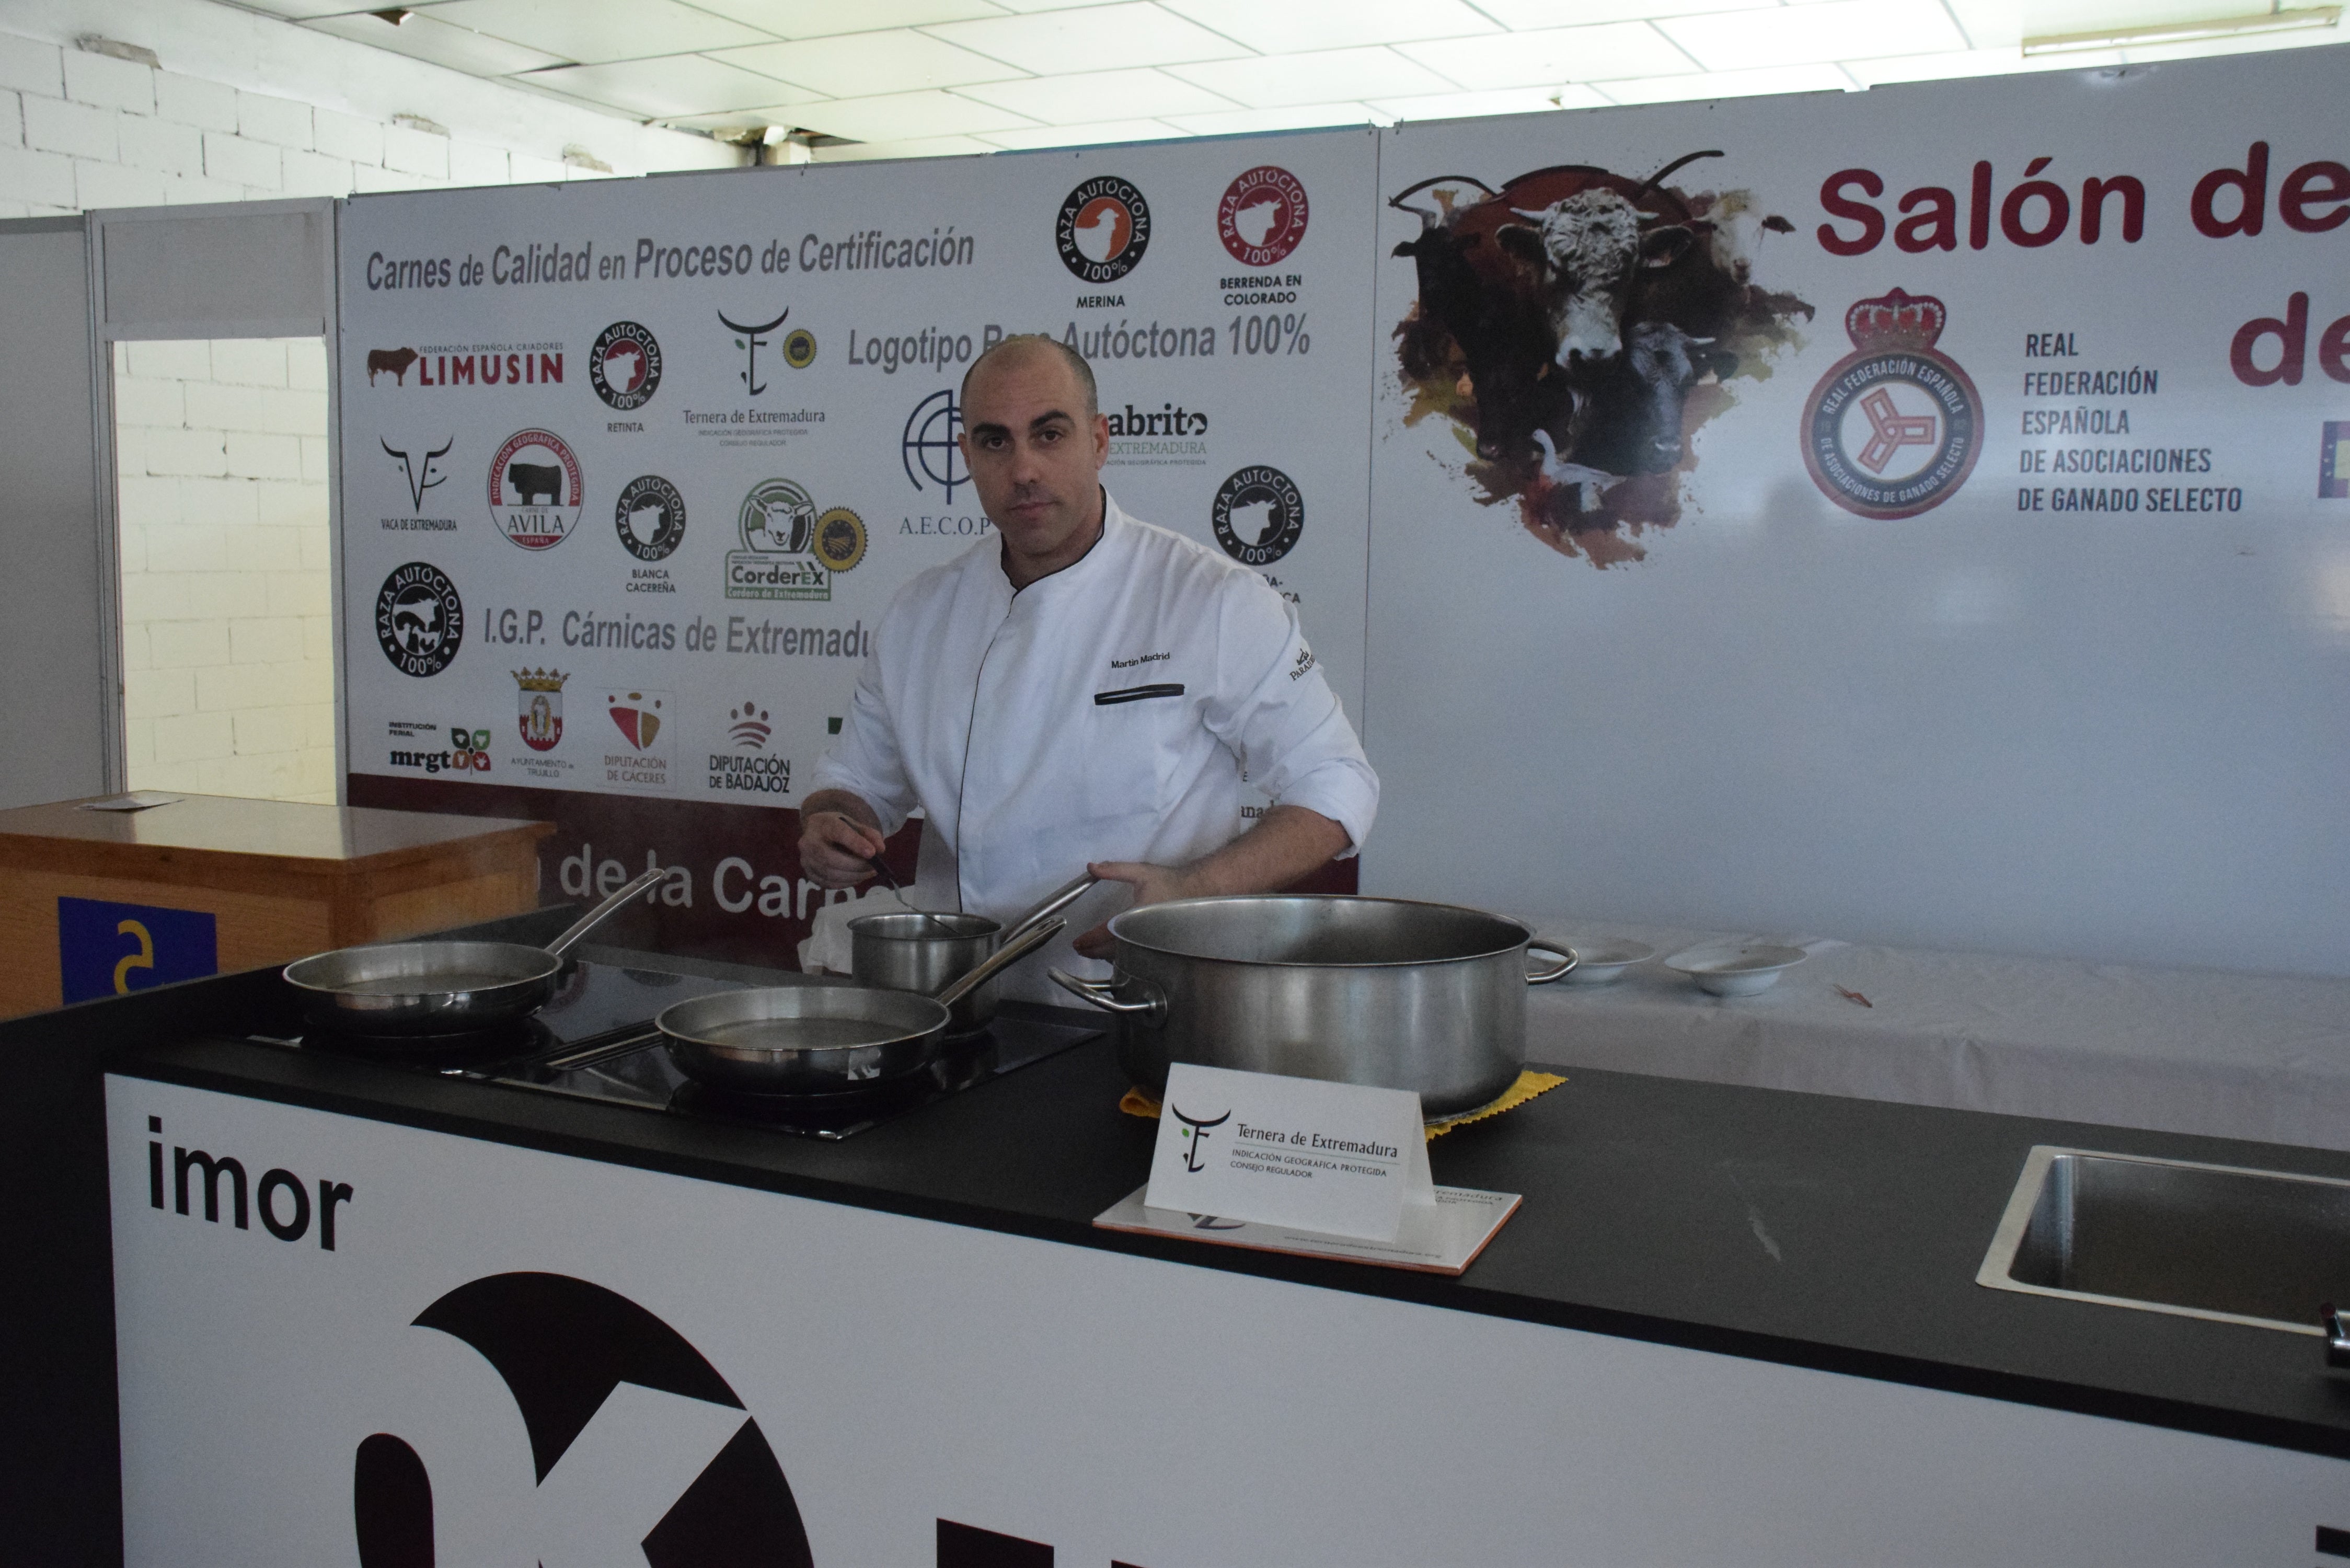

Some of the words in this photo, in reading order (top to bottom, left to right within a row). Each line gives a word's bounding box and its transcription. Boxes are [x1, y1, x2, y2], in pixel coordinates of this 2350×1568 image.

[1222, 194, 1238, 238] RAZA
[1238, 169, 1306, 229] AUTÓCTONA
[1816, 156, 2146, 257] Salón
[2190, 141, 2350, 238] de
[1062, 206, 1077, 252] RAZA
[1076, 179, 1147, 244] AUTÓCTONA
[367, 251, 451, 291] Carnes
[459, 255, 484, 286] de
[492, 241, 592, 285] Calidad
[599, 253, 626, 280] en
[634, 237, 753, 279] Proceso
[762, 239, 790, 274] de
[799, 226, 974, 272] Certificación
[1242, 245, 1287, 263] 100%
[1082, 261, 1128, 281] 100%
[1220, 275, 1282, 290] BERRENDA
[1286, 274, 1302, 287] EN
[1076, 295, 1125, 309] MERINA
[1224, 291, 1297, 306] COLORADO
[420, 345, 468, 353] FEDERACIÓN
[472, 342, 513, 352] ESPAÑOLA
[516, 342, 563, 351] CRIADORES
[593, 345, 606, 385] RAZA
[605, 324, 659, 379] AUTÓCTONA
[848, 326, 972, 374] Logotipo
[1063, 318, 1215, 360] Autóctona
[1228, 313, 1310, 356] 100%
[2025, 332, 2079, 358] REAL
[420, 353, 563, 386] LIMUSIN
[2023, 366, 2158, 396] FEDERACIÓN
[1823, 385, 1848, 415] REAL
[1845, 358, 1916, 391] FEDERACIÓN
[1917, 365, 1965, 414] ESPAÑOLA
[610, 393, 646, 408] 100%
[607, 422, 644, 433] RETINTA
[683, 410, 727, 423] Ternera
[731, 410, 745, 423] de
[749, 409, 825, 423] Extremadura
[1107, 403, 1208, 436] abrito
[2022, 406, 2130, 435] ESPAÑOLA
[1109, 442, 1207, 454] EXTREMADURA
[1824, 451, 1880, 502] ASOCIACIONES
[1883, 491, 1896, 503] DE
[1899, 476, 1939, 502] GANADO
[1937, 437, 1965, 479] SELECTO
[2020, 449, 2047, 474] DE
[2053, 448, 2212, 474] ASOCIACIONES
[619, 498, 631, 536] RAZA
[630, 478, 683, 531] AUTÓCTONA
[1218, 492, 1233, 535] RAZA
[1233, 469, 1300, 531] AUTÓCTONA
[2018, 488, 2044, 512] DE
[2052, 488, 2139, 512] GANADO
[2145, 488, 2242, 512] SELECTO
[381, 519, 399, 530] VACA
[400, 519, 409, 530] DE
[410, 518, 457, 531] EXTREMADURA
[508, 514, 565, 533] AVILA
[636, 543, 670, 559] 100%
[1238, 546, 1282, 562] 100%
[632, 569, 669, 579] BLANCA
[626, 580, 676, 594] CACEREÑA
[379, 590, 395, 638] RAZA
[395, 566, 460, 640] AUTÓCTONA
[485, 608, 545, 645] I.G.P.
[562, 610, 676, 651] Cárnicas
[686, 615, 717, 652] de
[399, 653, 441, 674] 100%
[1141, 652, 1170, 663] Madrid
[389, 722, 436, 730] INSTITUCIÓN
[390, 750, 451, 773] mrgt
[527, 768, 559, 777] TRUJILLO
[605, 755, 666, 769] DIPUTACIÓN
[710, 753, 790, 776] DIPUTACIÓN
[607, 770, 618, 781] DE
[622, 768, 665, 783] CÁCERES
[709, 776, 722, 788] DE
[726, 774, 790, 793] BADAJOZ
[560, 843, 627, 898] de
[647, 849, 693, 909] la
[1237, 1123, 1285, 1143] Ternera
[1291, 1132, 1307, 1146] de
[1312, 1133, 1398, 1158] Extremadura
[1230, 1160, 1264, 1172] CONSEJO
[1266, 1165, 1312, 1178] REGULADOR
[1232, 1149, 1282, 1162] INDICACIÓN
[1284, 1156, 1337, 1170] GEOGRÁFICA
[1341, 1163, 1387, 1177] PROTEGIDA
[148, 1115, 354, 1252] imor
